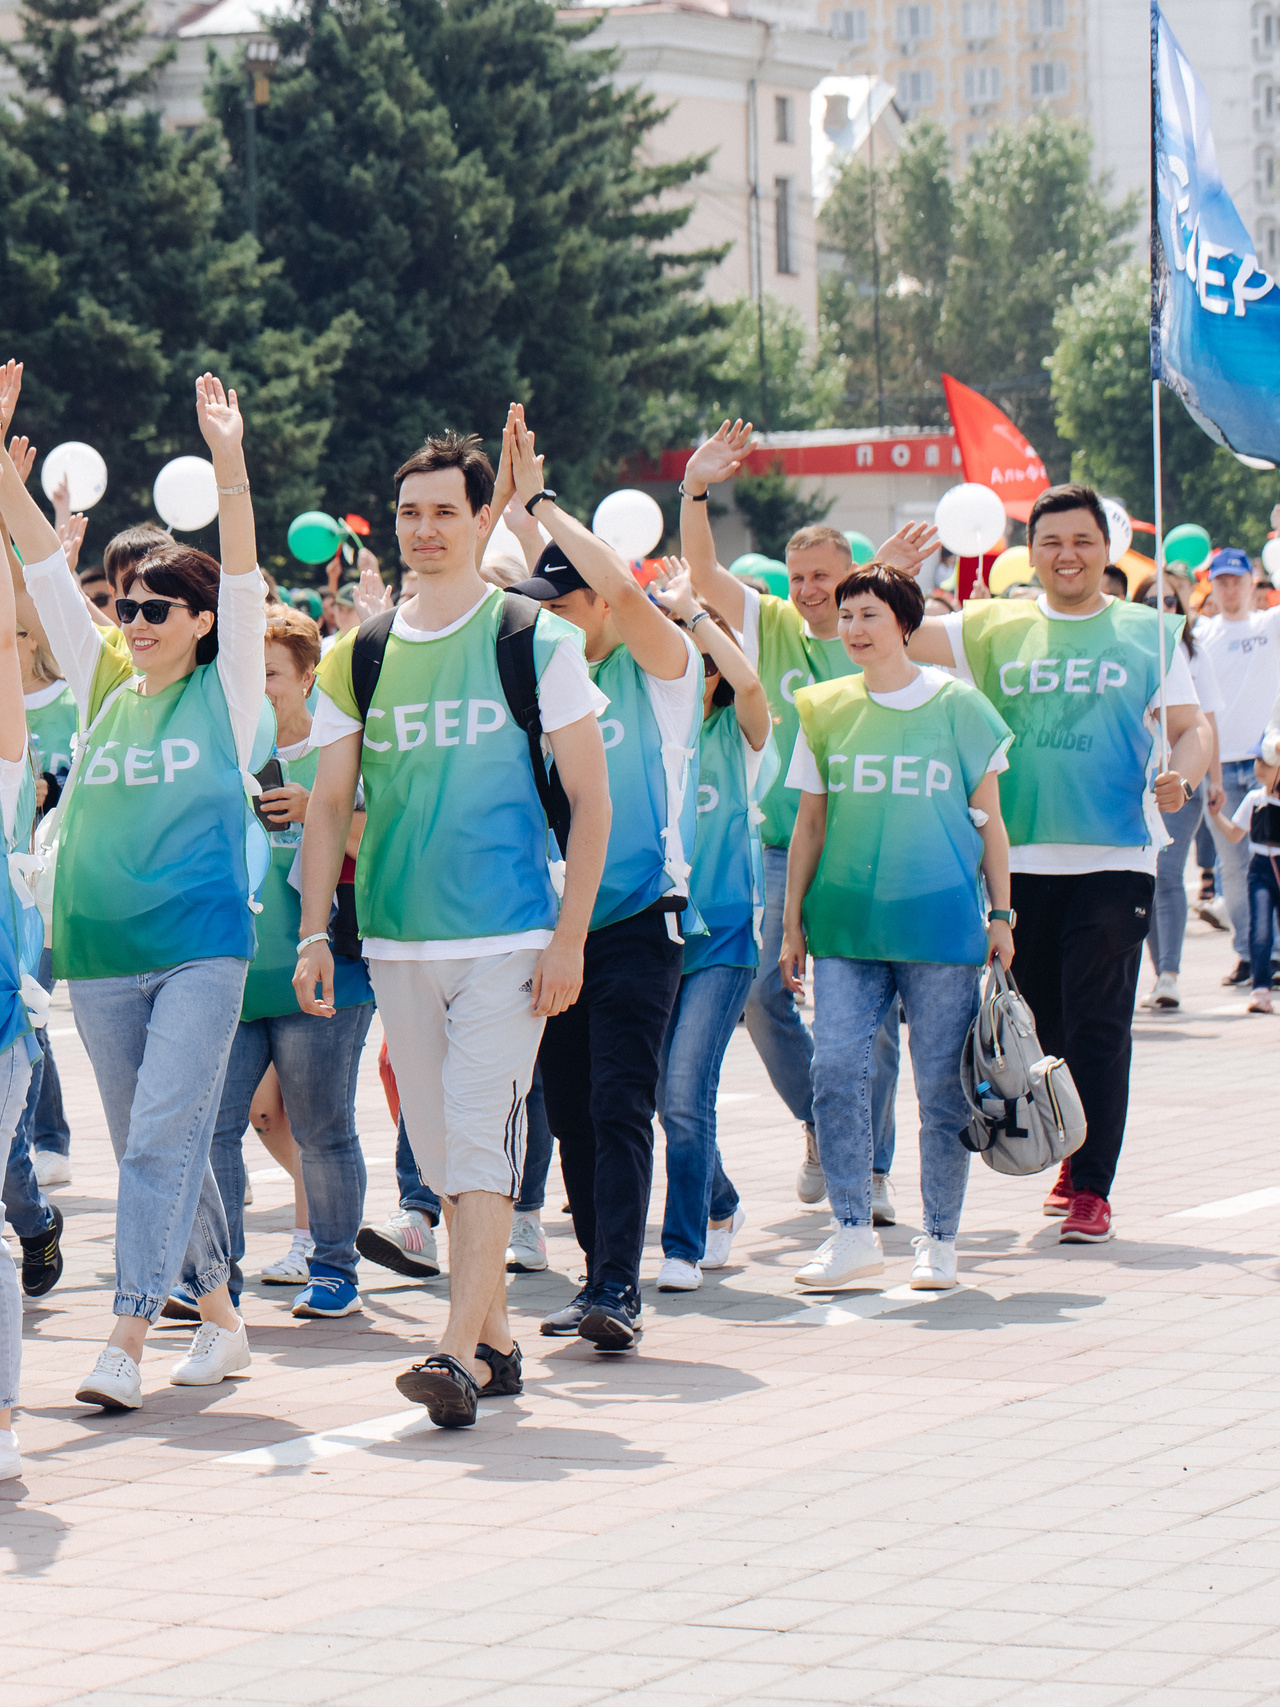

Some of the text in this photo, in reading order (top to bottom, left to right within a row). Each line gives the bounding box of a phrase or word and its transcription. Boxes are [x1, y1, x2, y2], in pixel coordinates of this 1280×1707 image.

[999, 658, 1128, 696] СБЕР
[363, 699, 506, 752] СБЕР
[78, 738, 200, 786] БЕР
[827, 754, 952, 797] СБЕР
